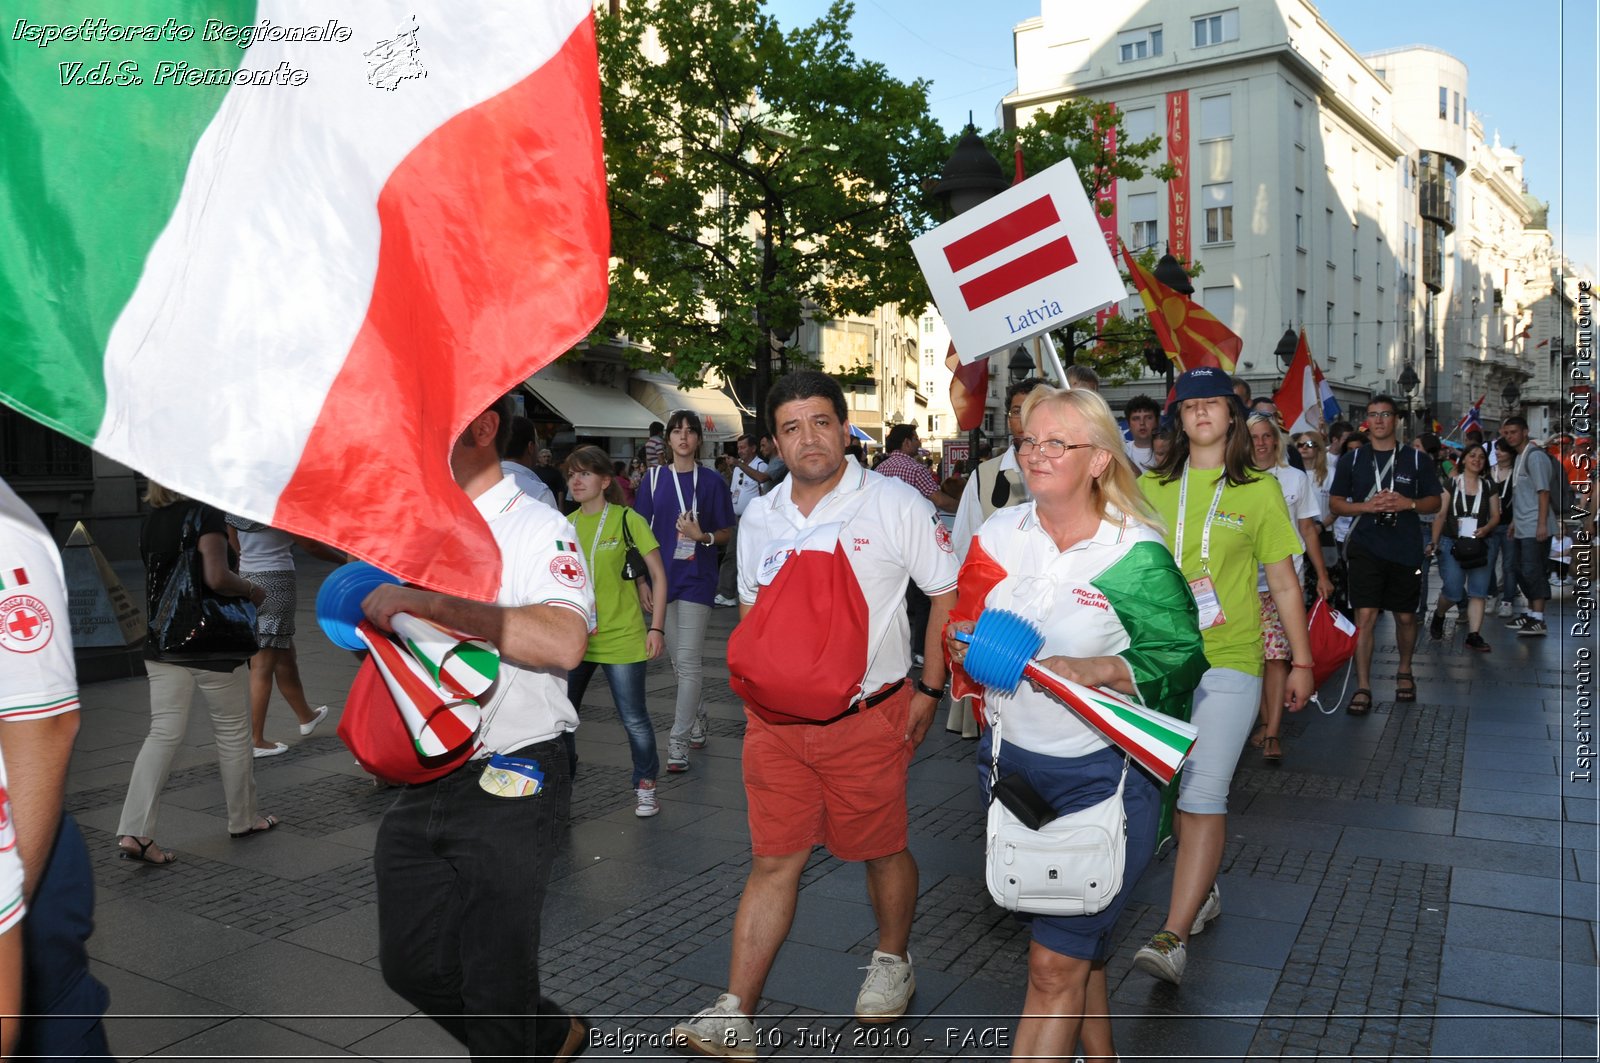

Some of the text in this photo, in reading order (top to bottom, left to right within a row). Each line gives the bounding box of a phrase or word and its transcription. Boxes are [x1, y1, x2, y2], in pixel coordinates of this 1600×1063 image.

[1173, 95, 1183, 142] UPIS
[1174, 156, 1184, 178] NA
[1004, 299, 1063, 334] Latvia
[1071, 588, 1097, 600] CROCE
